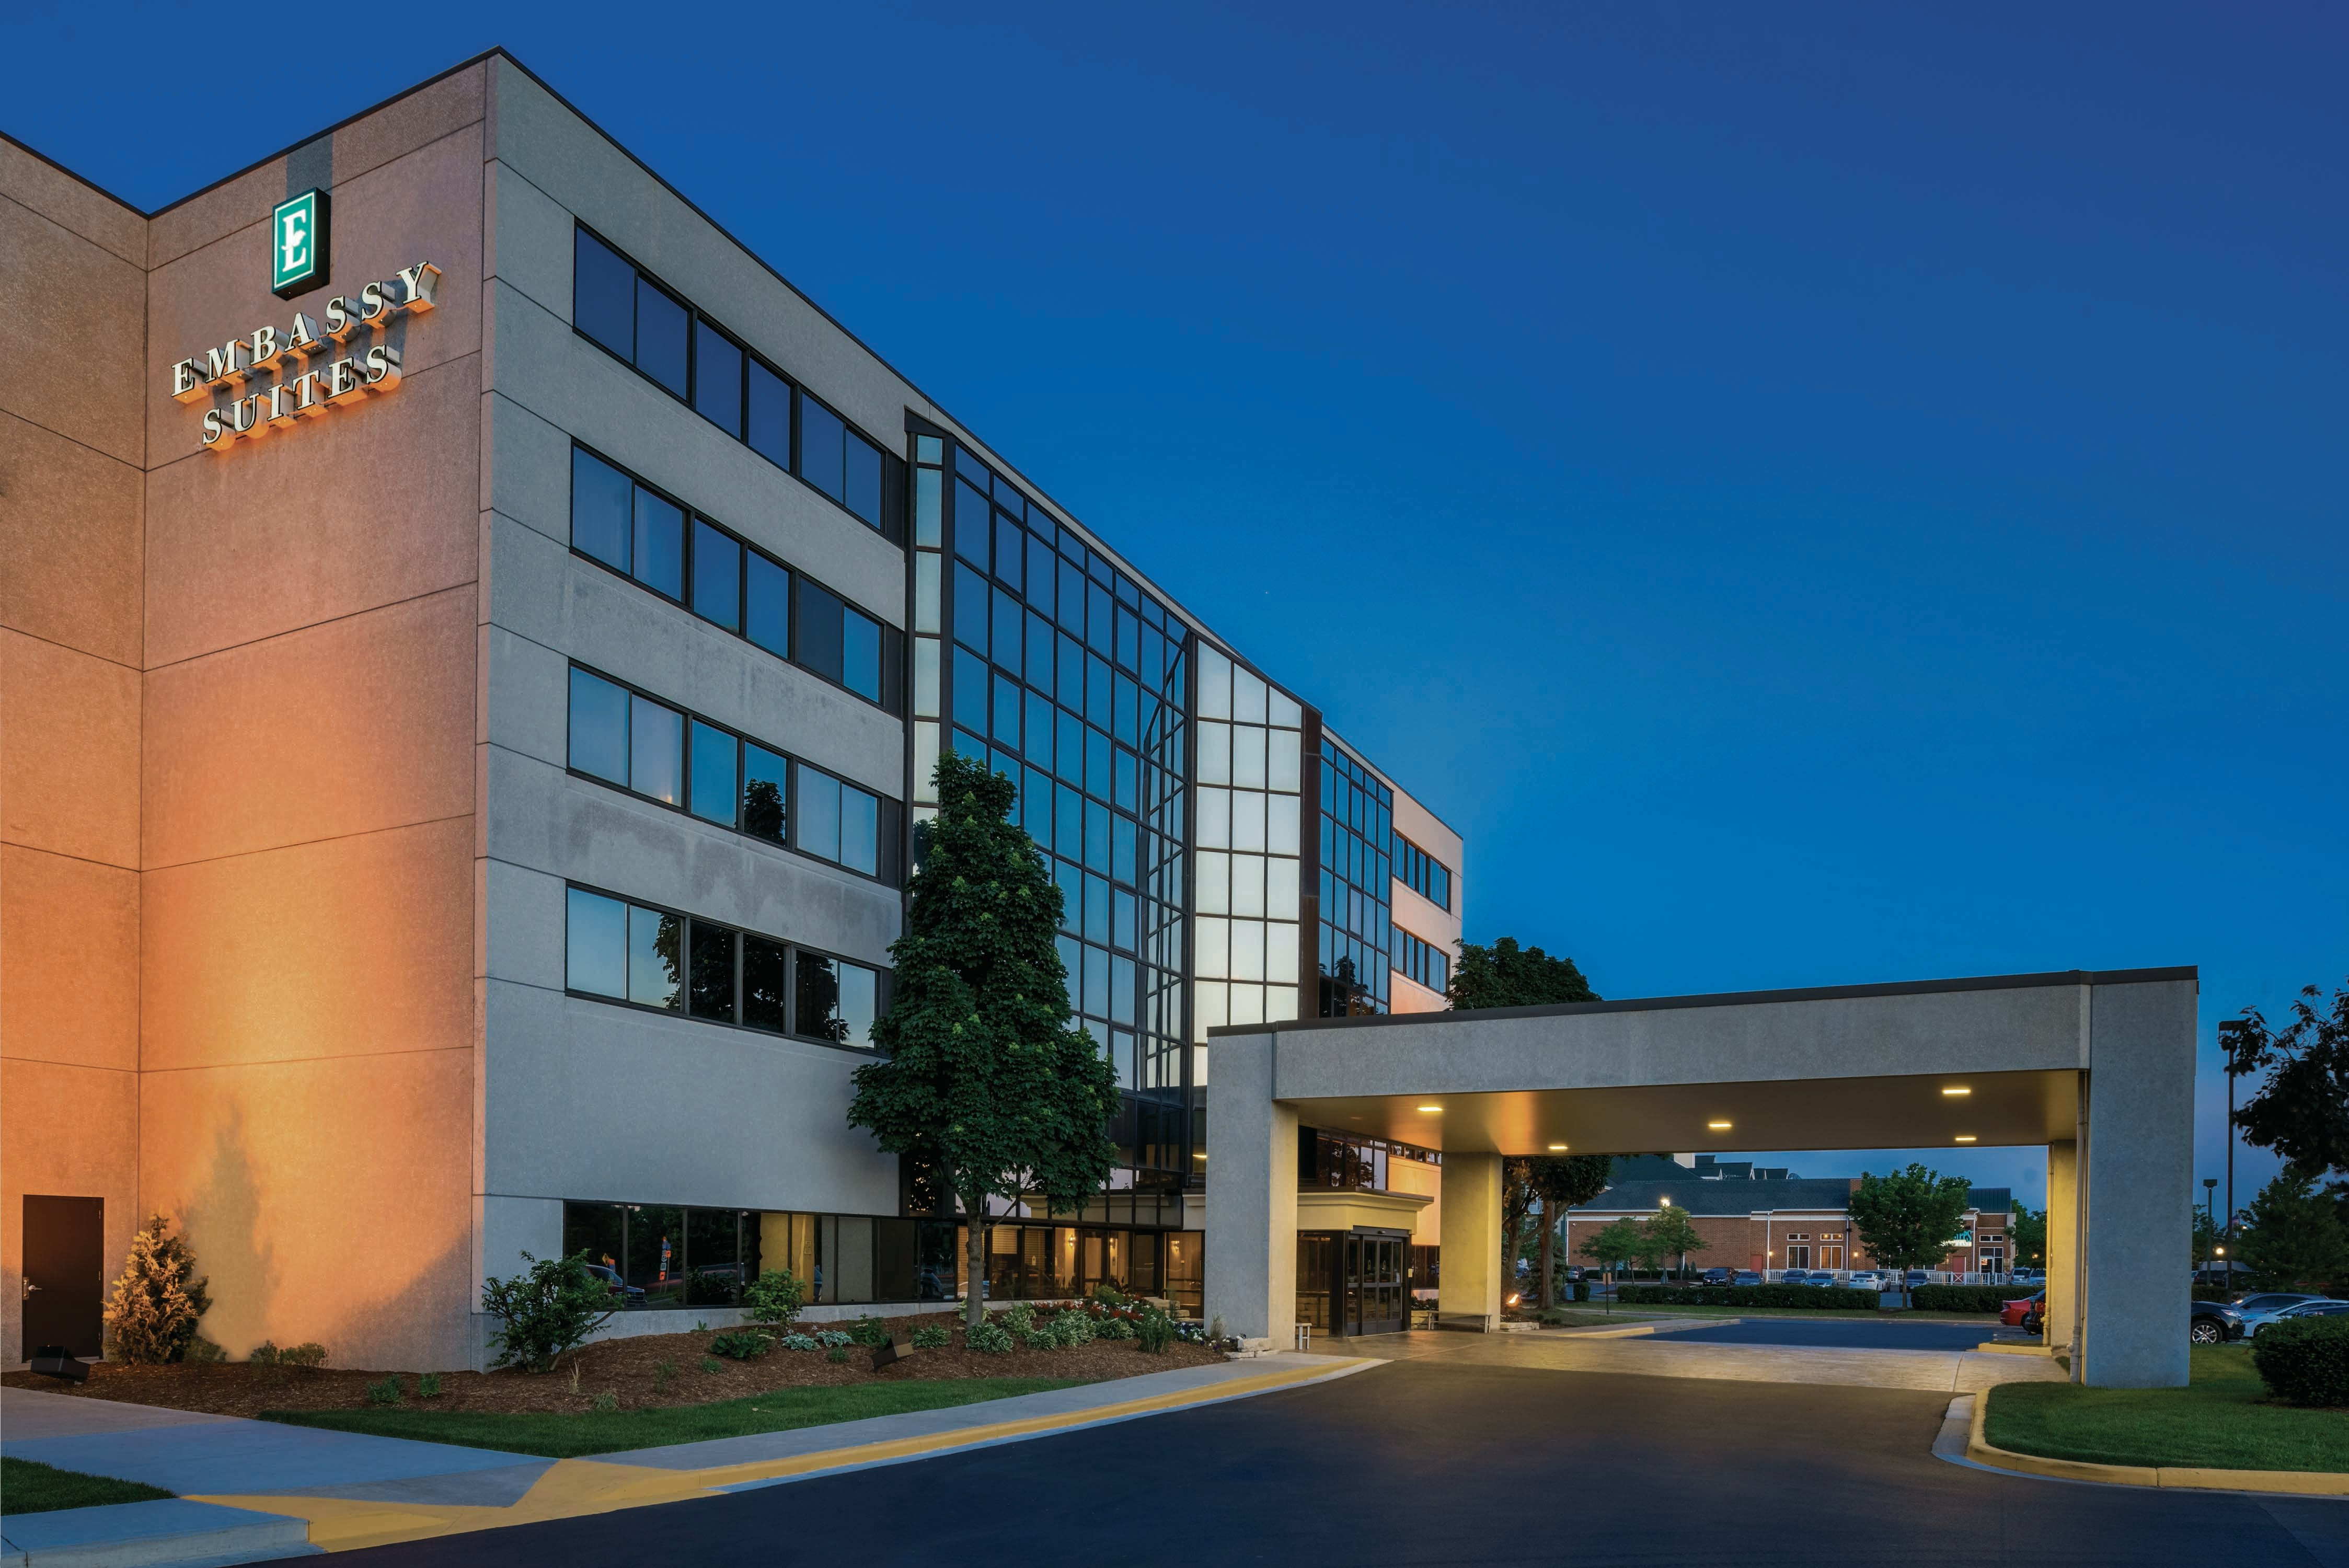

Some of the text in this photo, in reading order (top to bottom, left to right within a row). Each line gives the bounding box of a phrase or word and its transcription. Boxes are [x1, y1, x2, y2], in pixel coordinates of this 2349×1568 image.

[281, 209, 306, 272] E
[171, 261, 429, 397] EMBASSY
[202, 344, 389, 445] SUITES
